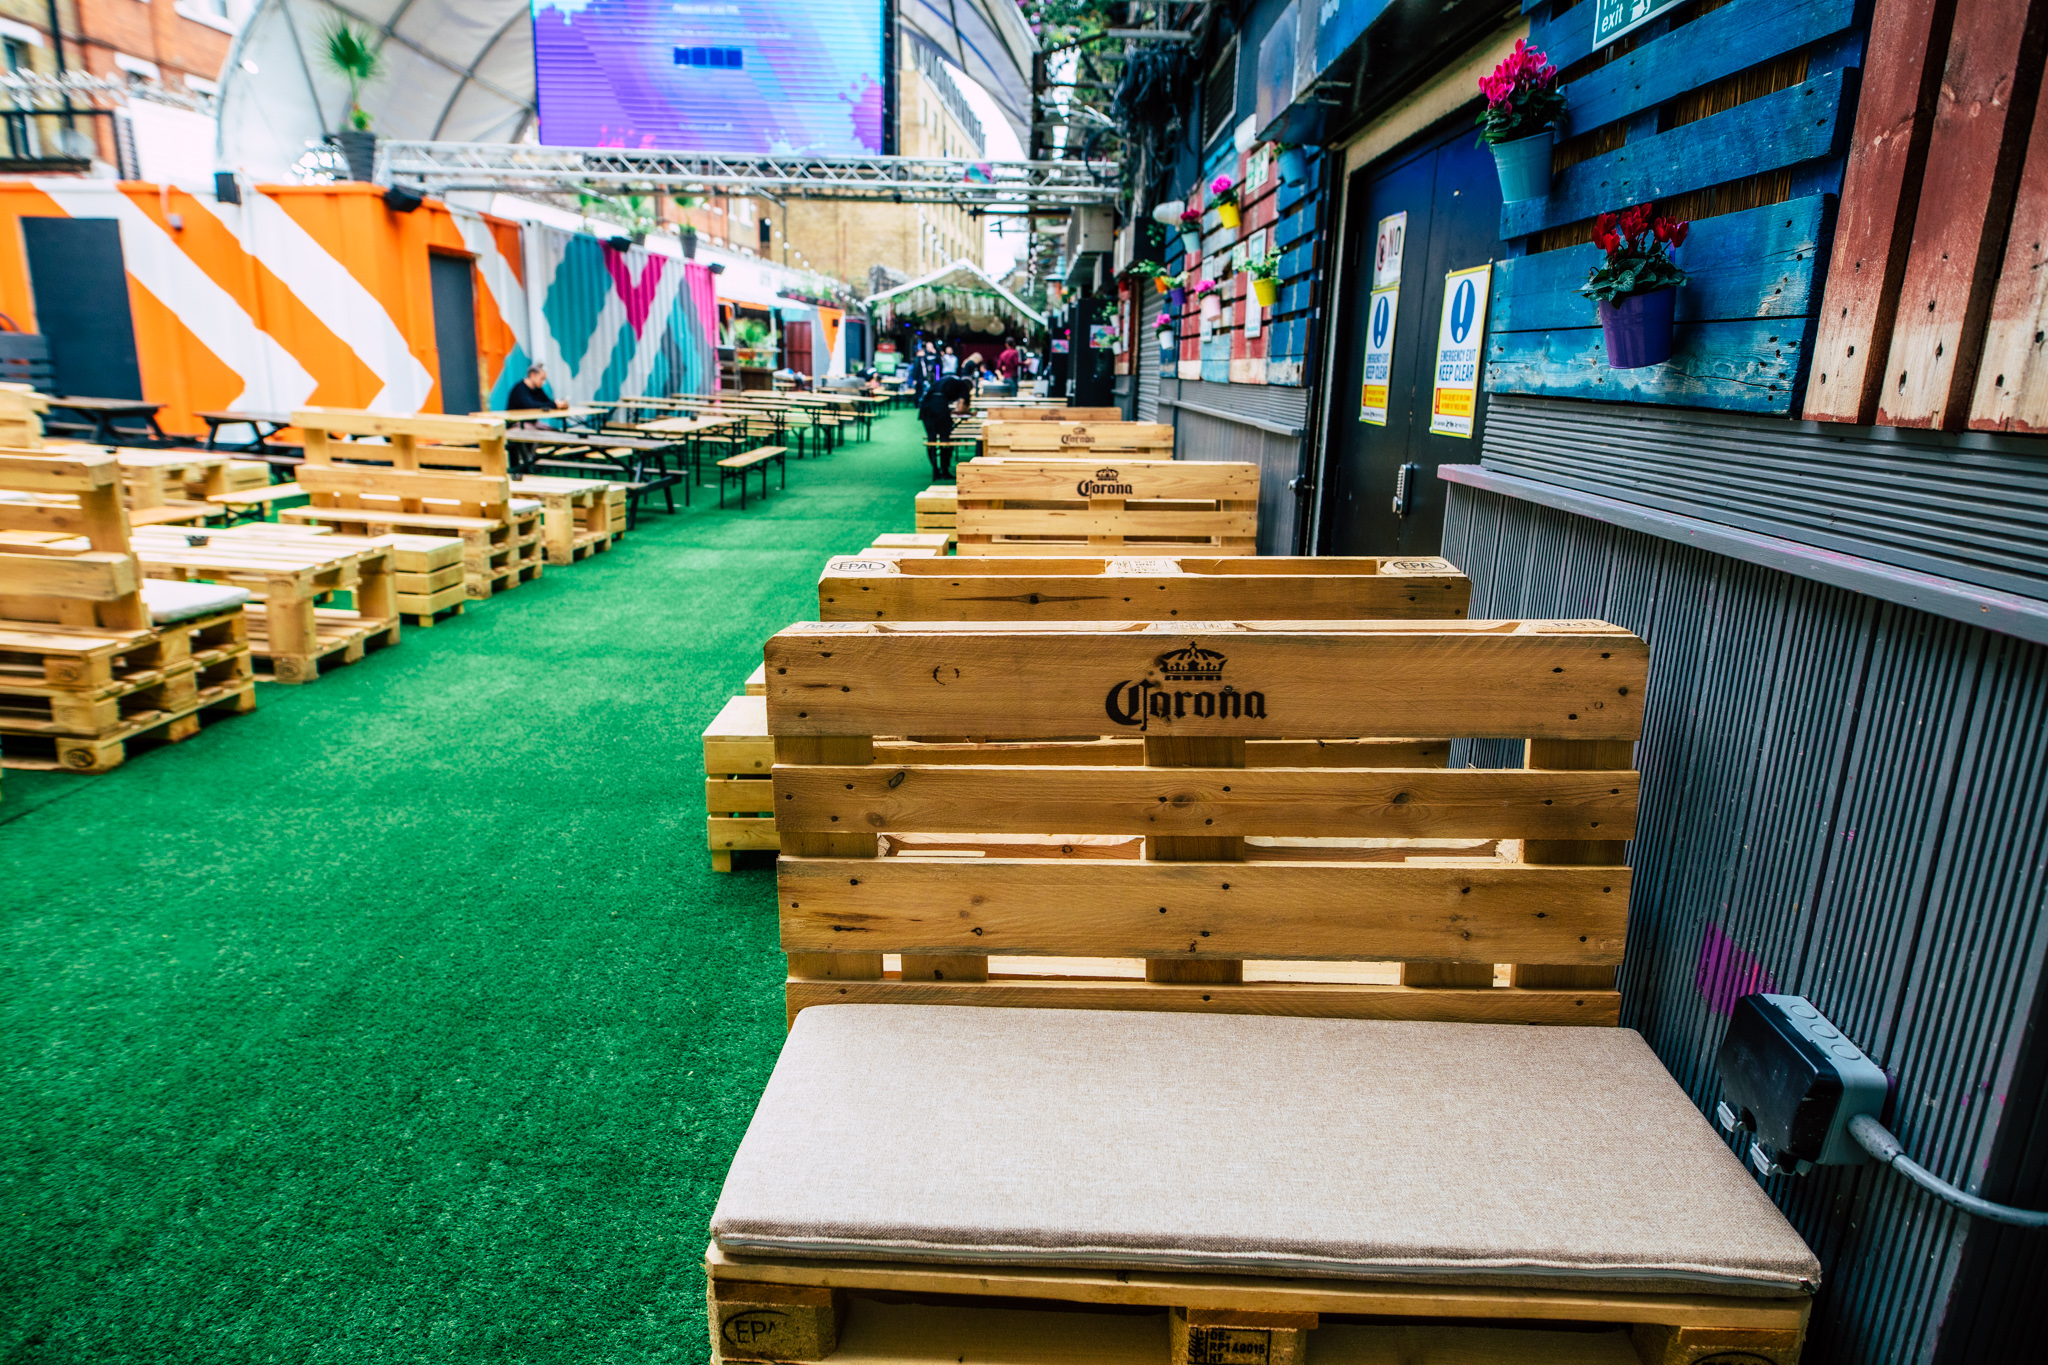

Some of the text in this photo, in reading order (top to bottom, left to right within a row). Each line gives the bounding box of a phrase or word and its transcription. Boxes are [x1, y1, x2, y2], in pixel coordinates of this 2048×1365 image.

[1601, 3, 1624, 33] exit
[1387, 226, 1402, 257] NO
[1440, 349, 1476, 362] EMERGENCY EXIT
[1439, 364, 1475, 381] KEEP CLEAR
[1061, 434, 1095, 445] Corona
[1077, 480, 1133, 499] Corona
[1105, 678, 1268, 732] Corona
